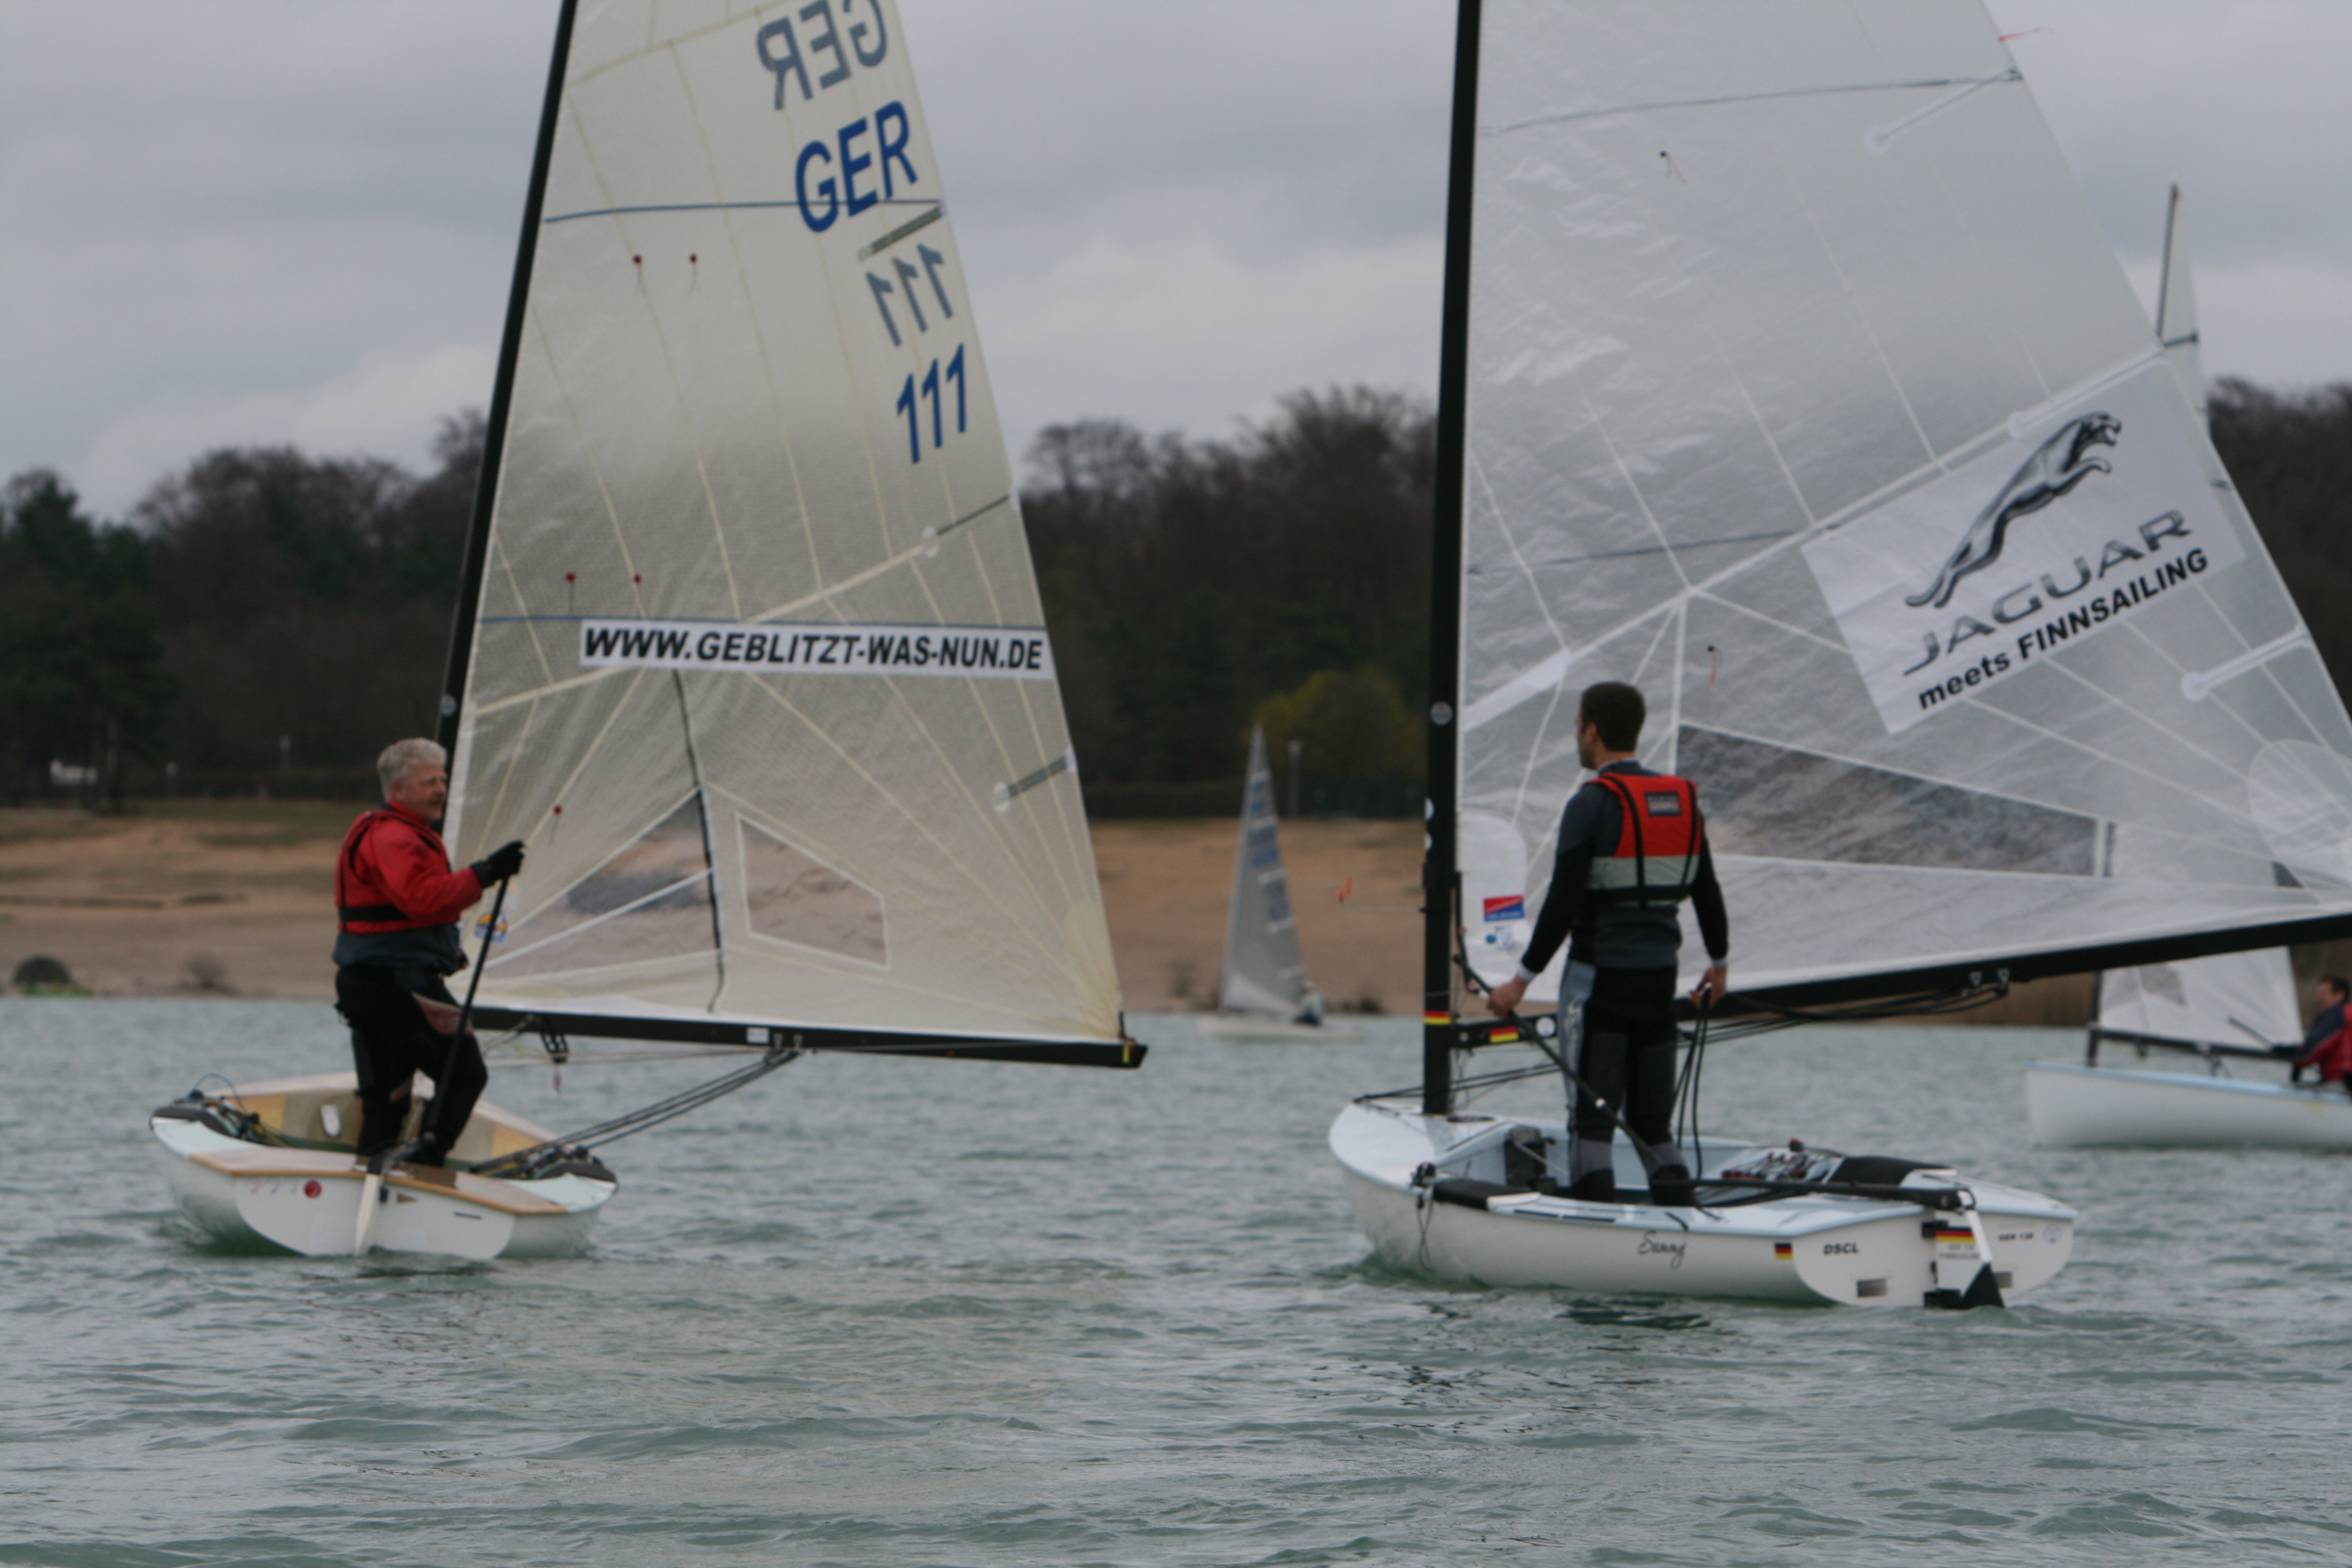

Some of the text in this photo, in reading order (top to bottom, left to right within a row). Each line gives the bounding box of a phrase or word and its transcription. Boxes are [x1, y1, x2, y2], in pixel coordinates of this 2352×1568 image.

[795, 100, 918, 233] GER
[897, 343, 966, 463] 111
[584, 627, 1043, 670] WWW.GEBLITZT-WAS-NUN.DE
[1904, 509, 2194, 676] JAGUAR
[1919, 547, 2209, 710] meets FINNSAILING
[1823, 1242, 1860, 1255] DSCL
